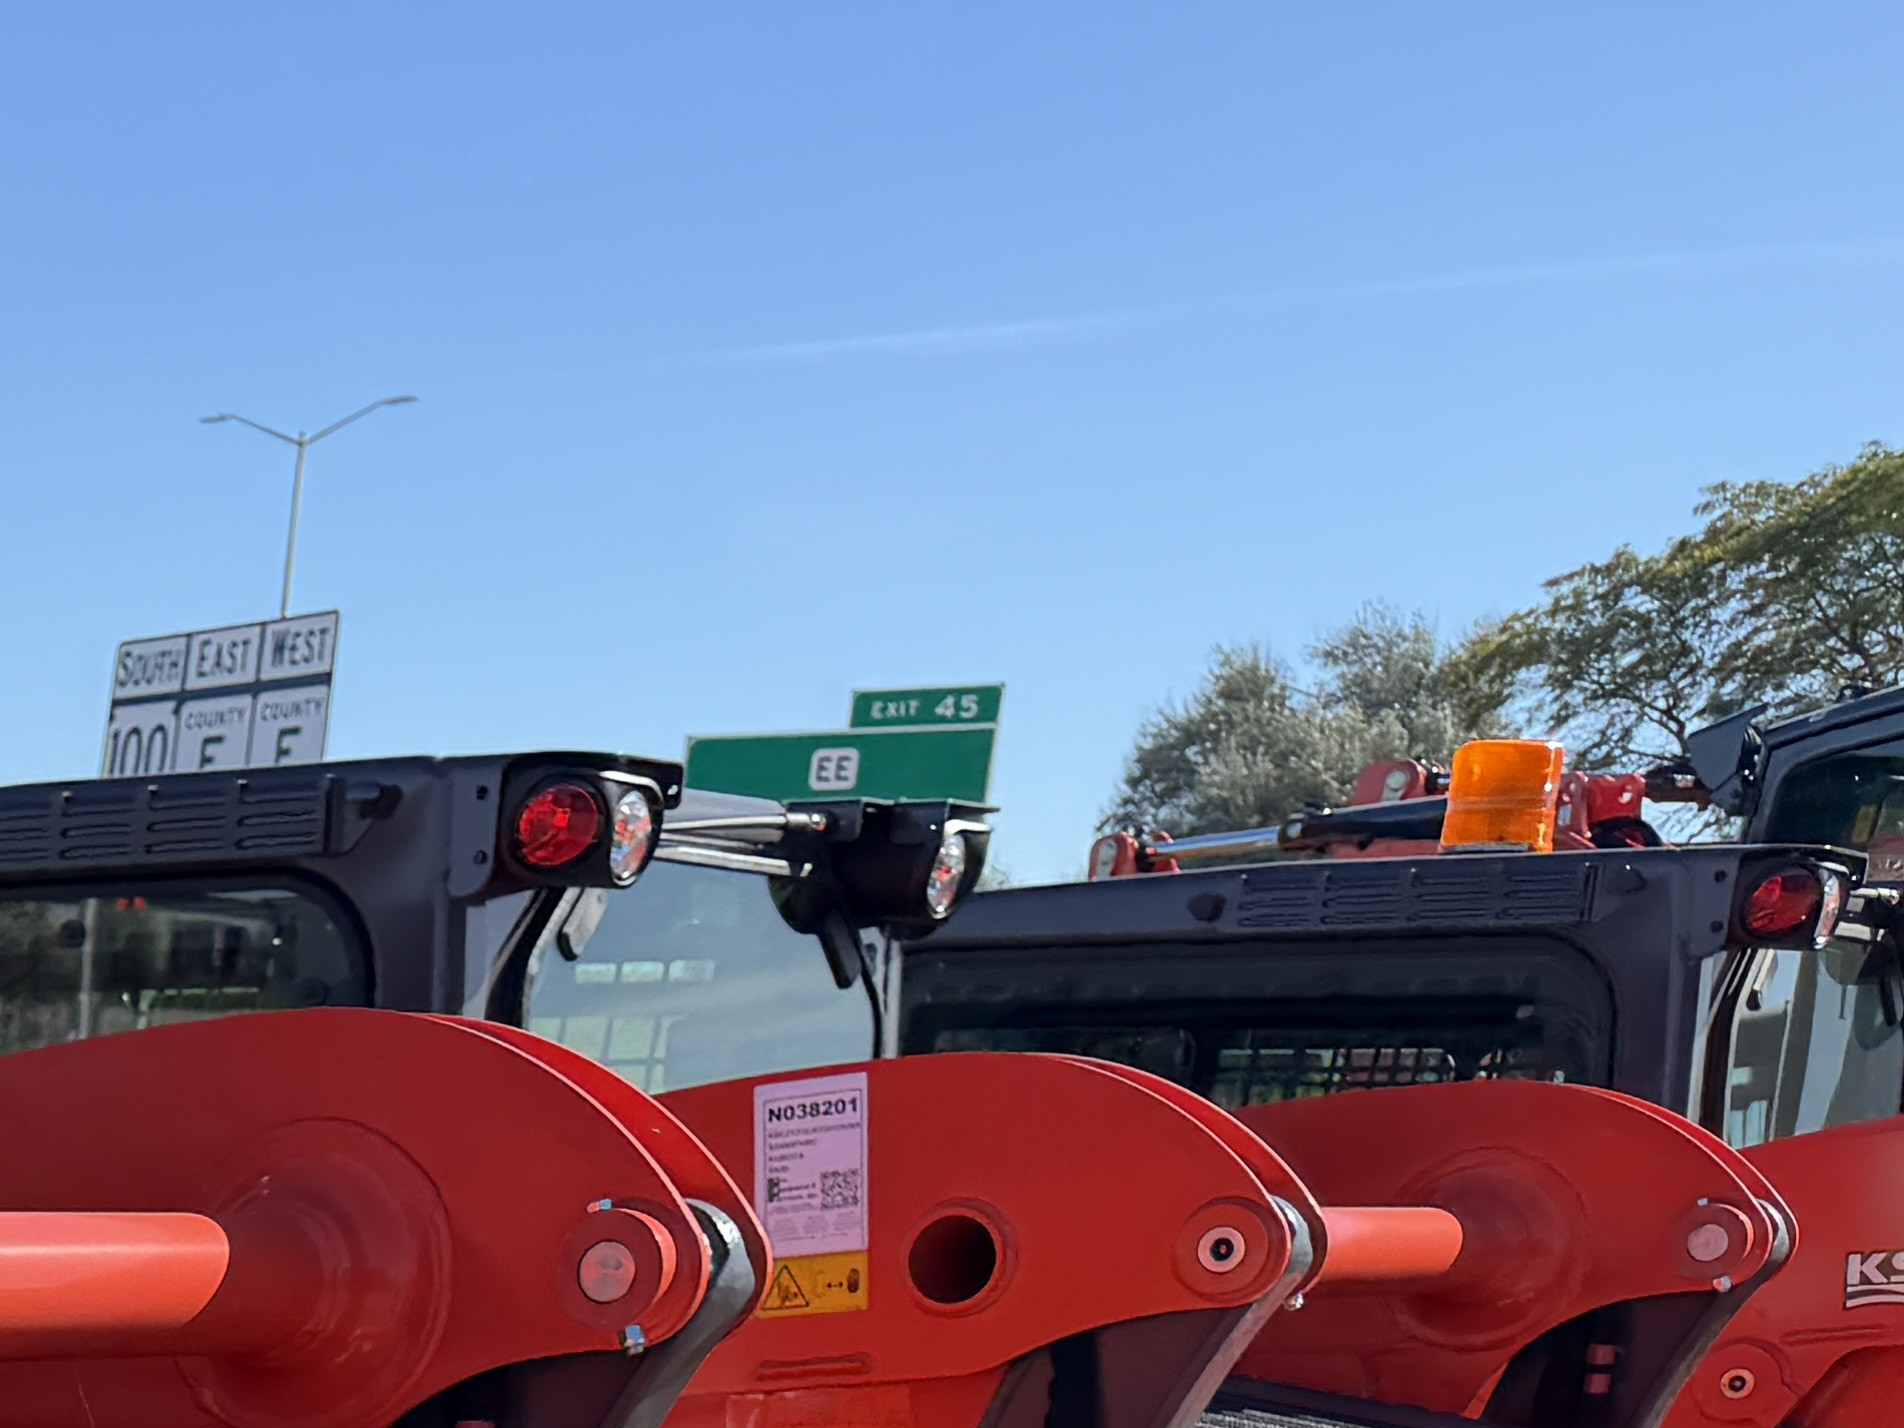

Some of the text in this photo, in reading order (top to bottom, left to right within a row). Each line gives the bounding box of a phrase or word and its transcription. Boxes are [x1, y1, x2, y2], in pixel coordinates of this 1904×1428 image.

[196, 637, 251, 678] EAST
[271, 627, 330, 667] WEST
[119, 649, 180, 686] SOUTH
[184, 706, 247, 730] COUNTY
[261, 697, 324, 721] COUNTY
[870, 694, 980, 719] EXIT 45
[109, 724, 168, 775] 100
[814, 754, 853, 783] EE
[767, 1097, 859, 1123] N038201
